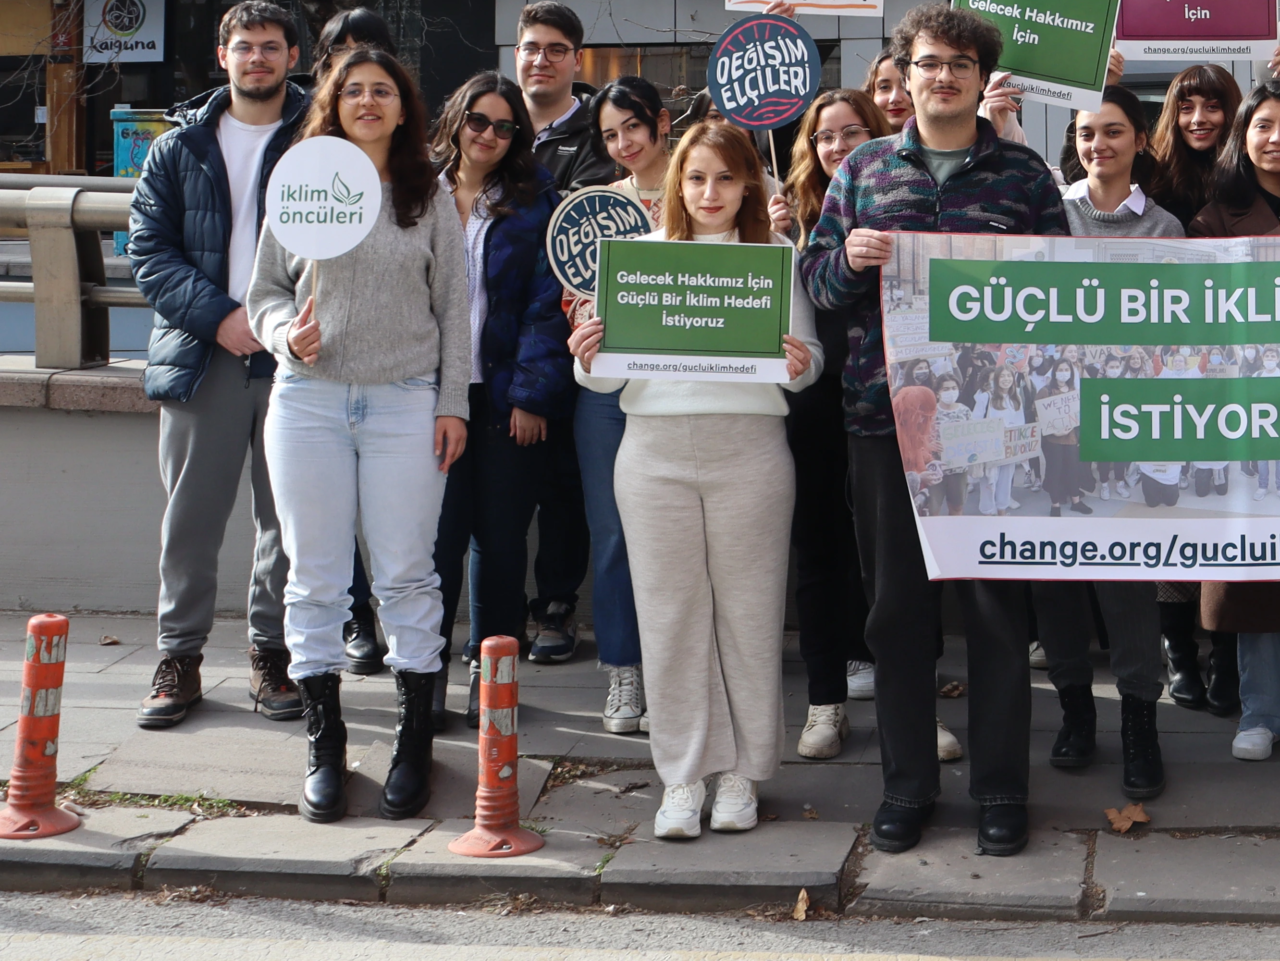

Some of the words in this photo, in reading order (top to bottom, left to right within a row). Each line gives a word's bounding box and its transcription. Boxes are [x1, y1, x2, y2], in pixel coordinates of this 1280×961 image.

[1024, 7, 1095, 34] Hakkımız
[1184, 3, 1210, 22] İçin
[1012, 23, 1039, 45] İçin
[1143, 45, 1251, 55] change.org/gucluiklimhedefi
[716, 35, 808, 85] DEĞİŞİM
[720, 63, 810, 110] ELÇİLERİ
[280, 184, 328, 202] iklim
[279, 206, 364, 224] öncüleri
[616, 270, 674, 286] Gelecek
[677, 273, 744, 288] Hakkımız
[747, 272, 773, 291] İçin
[616, 292, 658, 307] Güçlü
[662, 292, 682, 306] Bir
[686, 291, 720, 307] İklim
[724, 295, 771, 309] Hedefi
[948, 276, 1105, 332] GÜÇLÜ
[1120, 279, 1191, 324] BİR
[662, 310, 725, 329] İstiyoruz
[627, 361, 757, 374] change.org/gucluiklimhedefi
